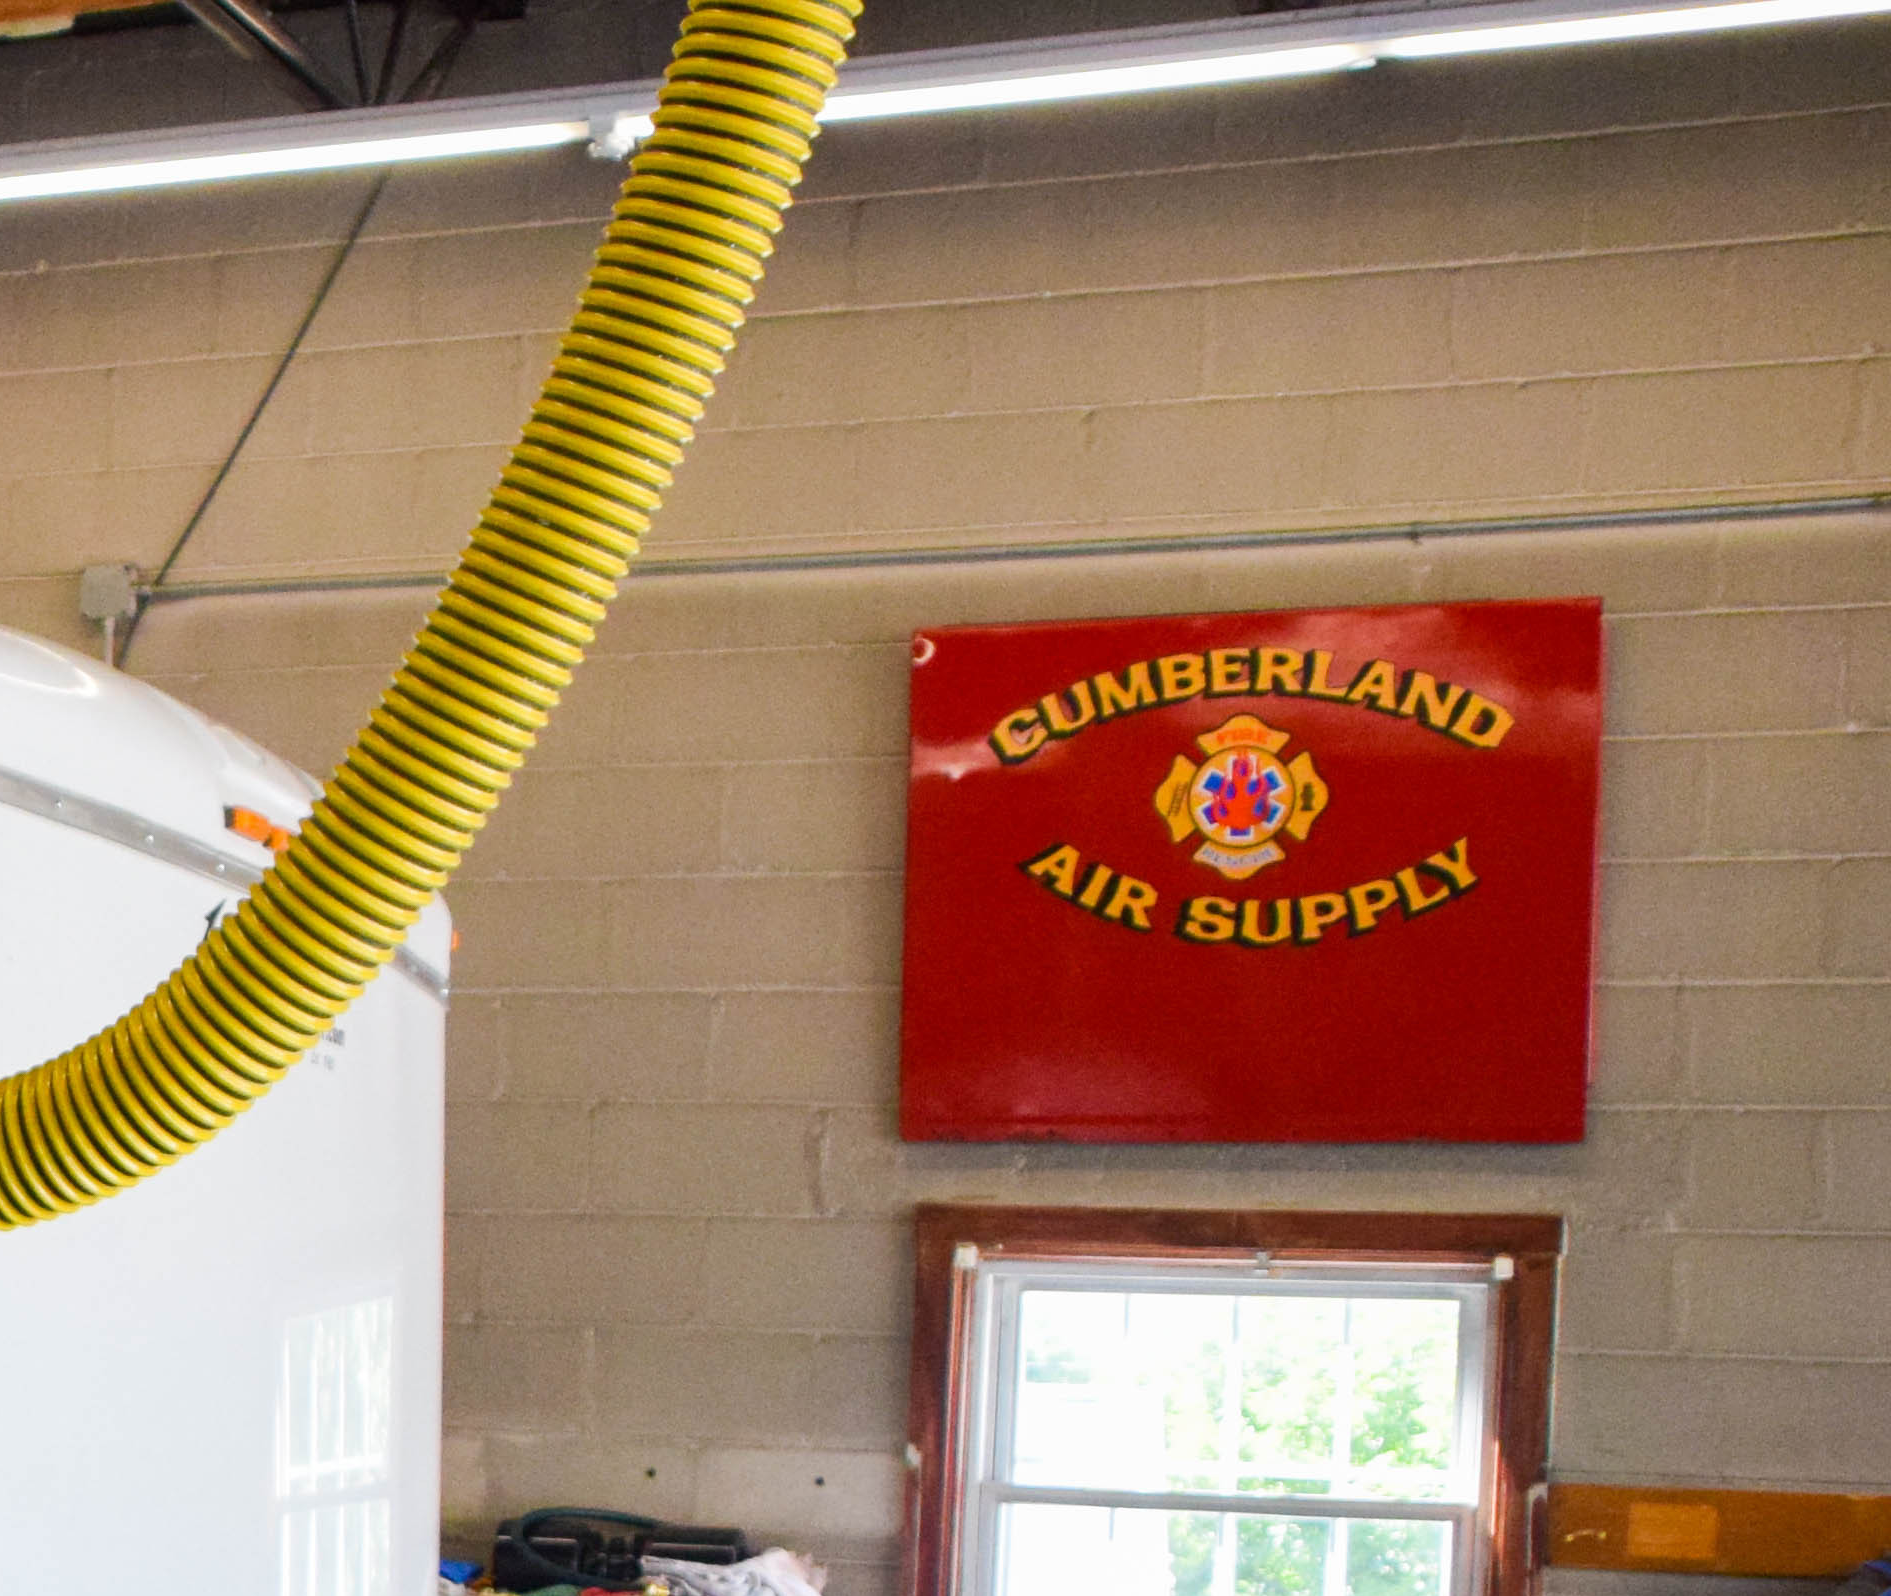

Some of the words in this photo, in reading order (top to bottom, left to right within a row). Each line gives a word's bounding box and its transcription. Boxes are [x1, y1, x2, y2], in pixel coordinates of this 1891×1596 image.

[989, 646, 1515, 764] CUMBERLAND
[1022, 843, 1159, 933] AIR
[1175, 836, 1480, 948] SUPPLY
